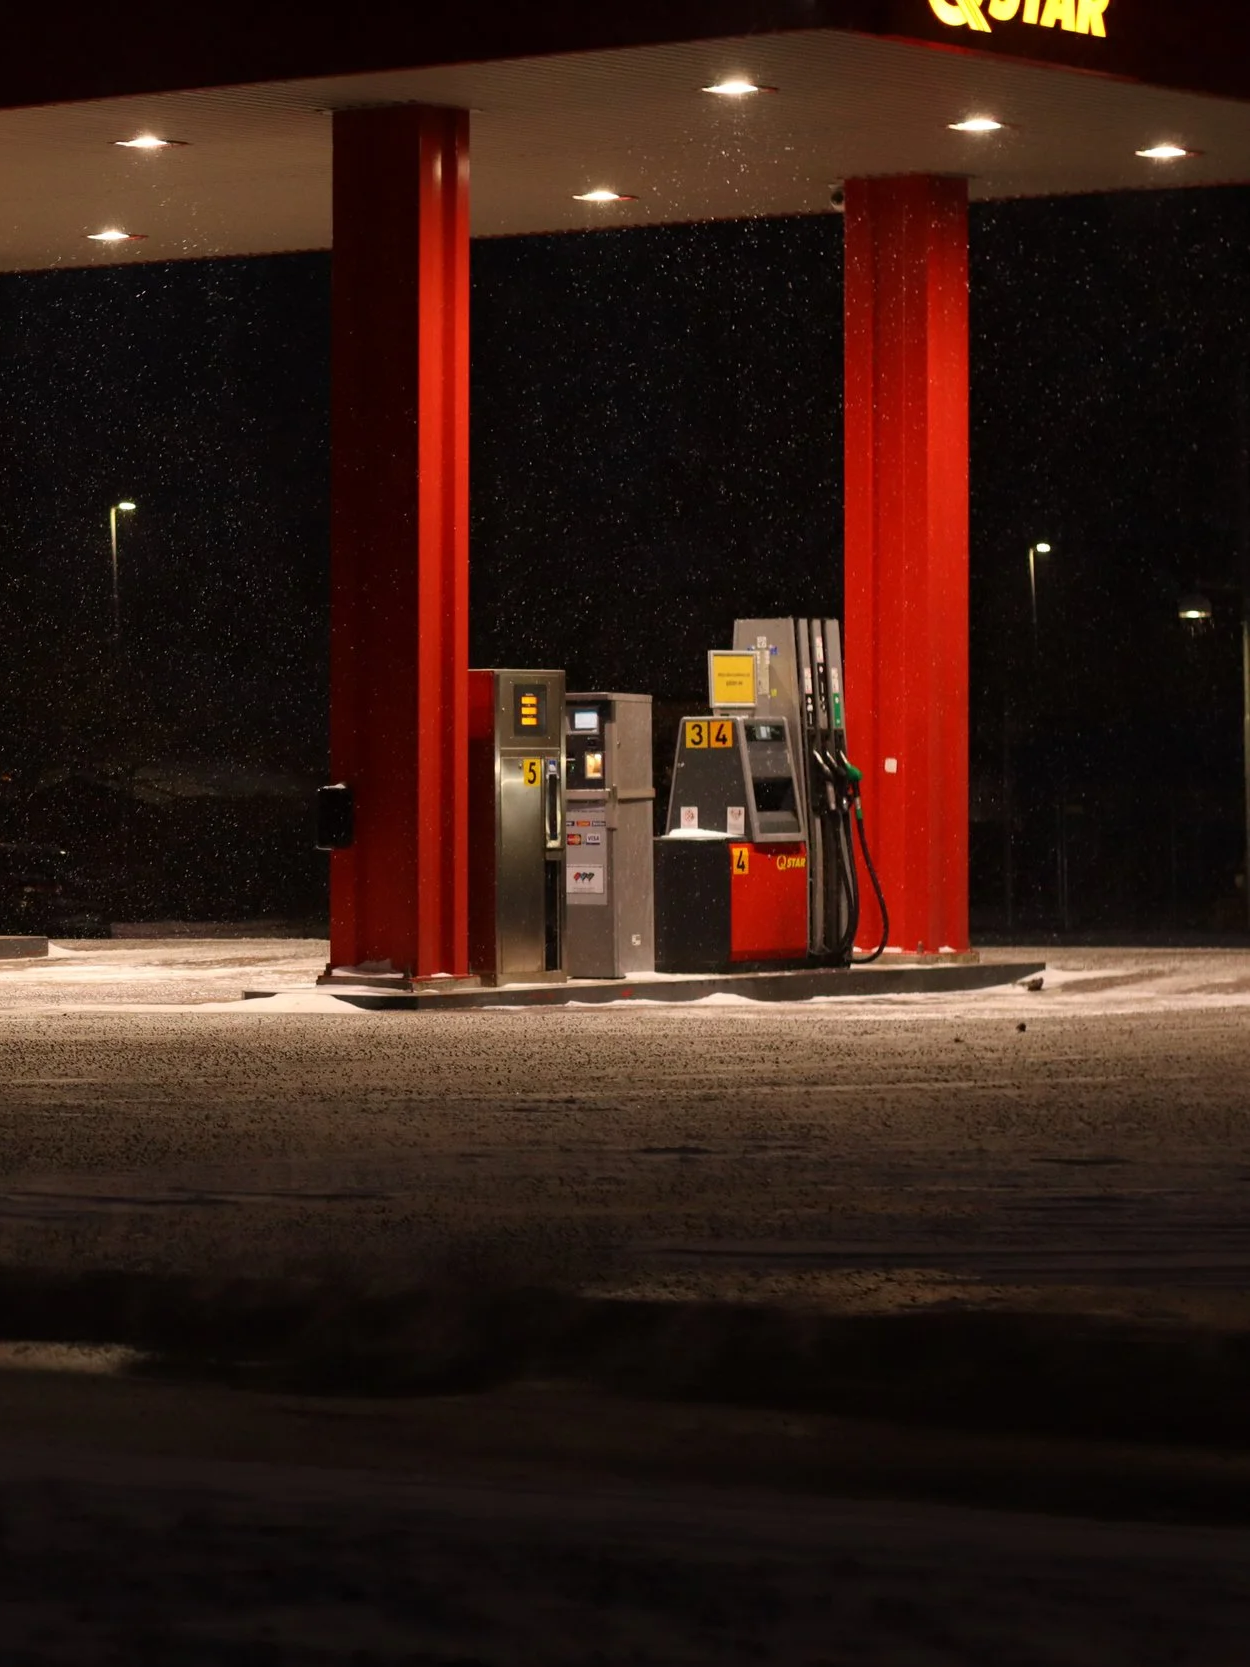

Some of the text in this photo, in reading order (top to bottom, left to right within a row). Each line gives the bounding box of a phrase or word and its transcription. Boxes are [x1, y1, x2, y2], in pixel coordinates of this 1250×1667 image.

[691, 724, 728, 746] 3 4
[527, 762, 537, 785] 5
[736, 850, 746, 872] 4
[776, 855, 806, 870] QSTAR
